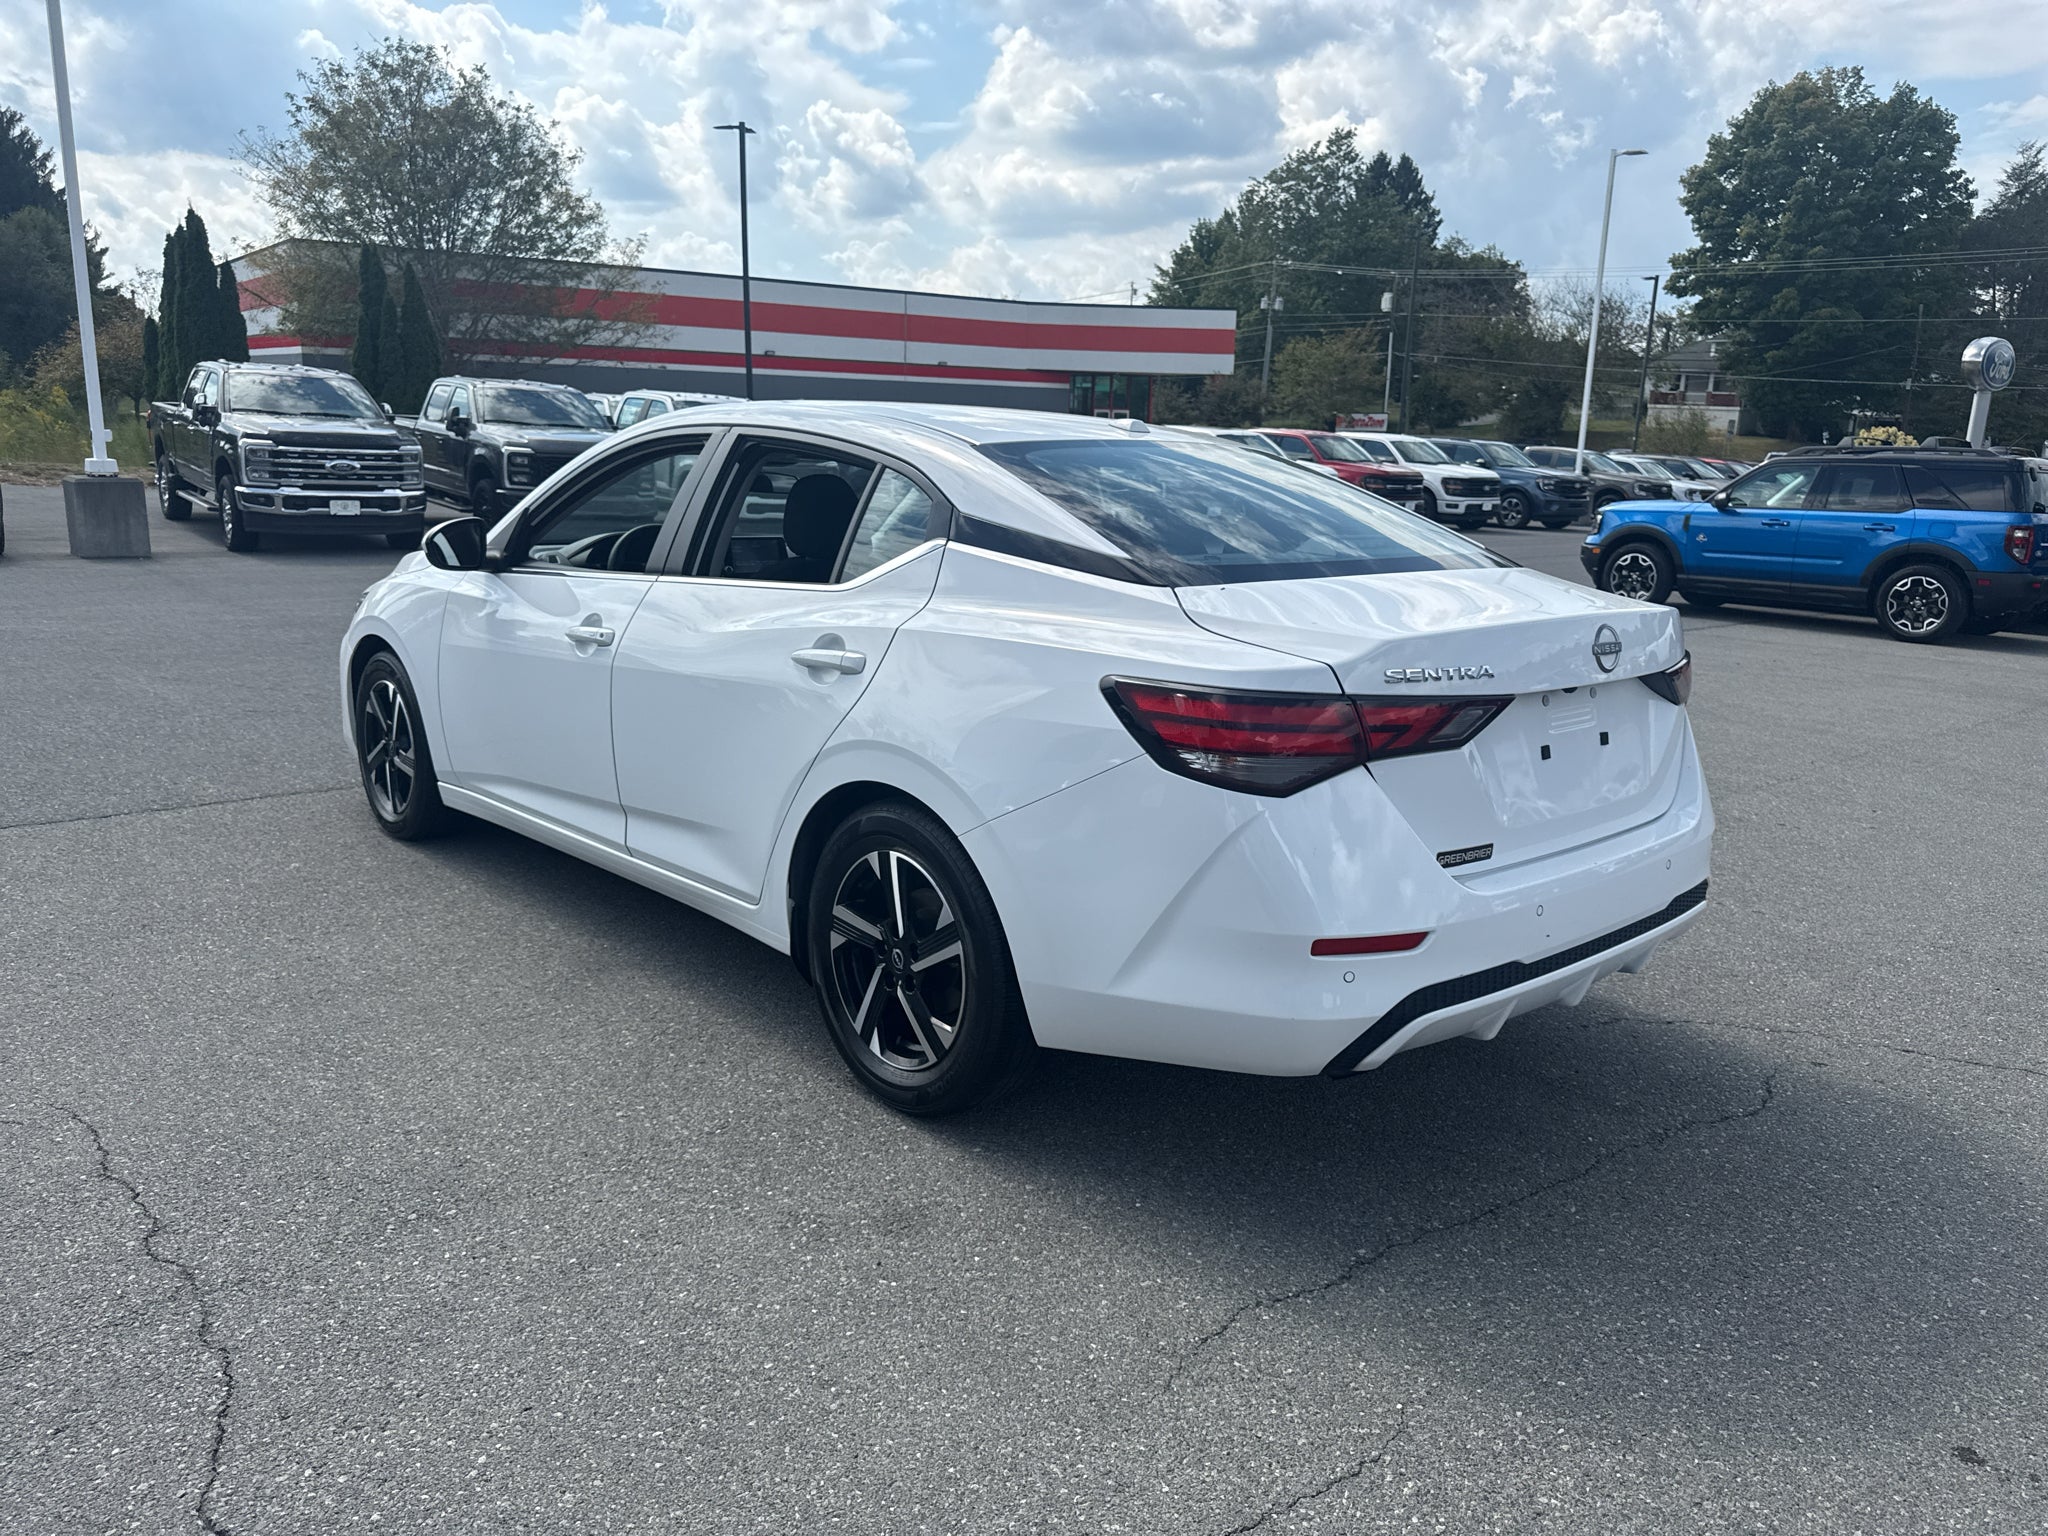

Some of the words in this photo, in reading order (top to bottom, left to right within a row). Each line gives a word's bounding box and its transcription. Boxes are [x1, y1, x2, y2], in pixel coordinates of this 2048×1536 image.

[1989, 350, 2013, 380] Ford
[1384, 665, 1495, 684] SENTRA
[1438, 847, 1492, 865] GREENBRIER
